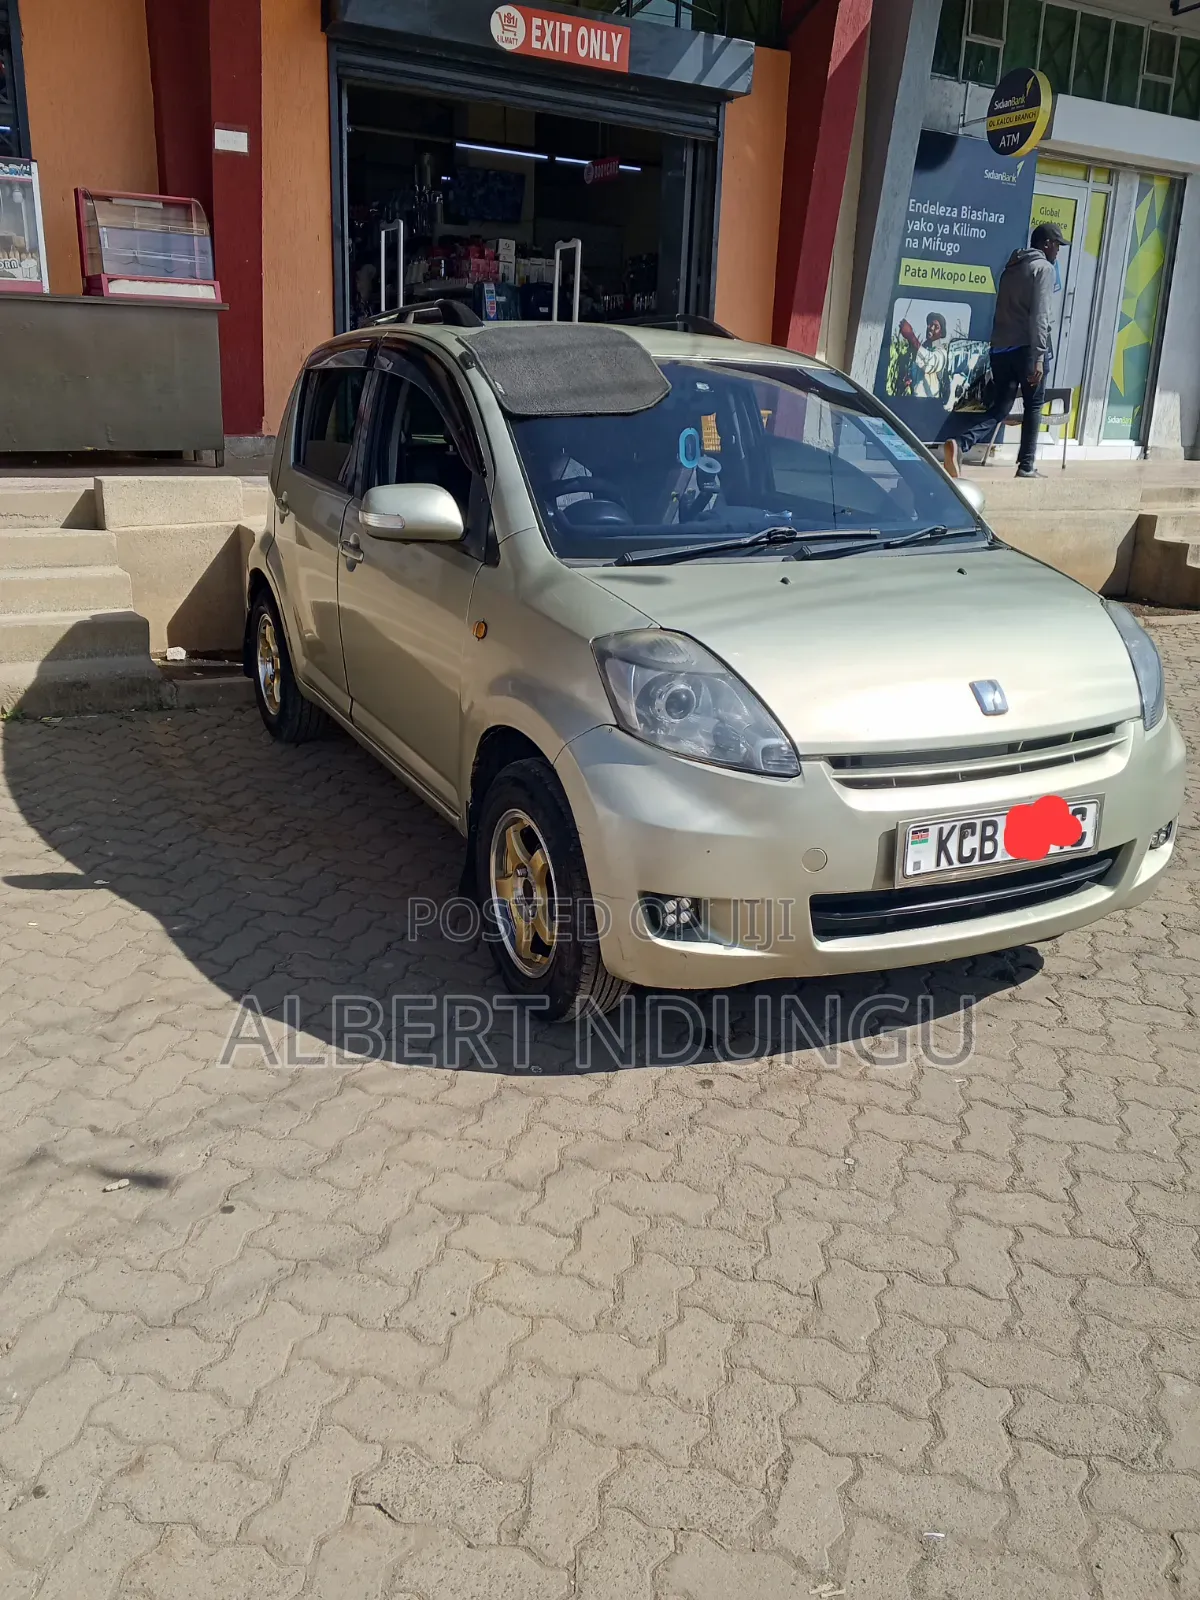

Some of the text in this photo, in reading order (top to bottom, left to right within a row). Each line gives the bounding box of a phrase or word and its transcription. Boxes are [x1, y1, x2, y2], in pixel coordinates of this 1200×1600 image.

[531, 17, 622, 63] EXIT ONLY
[993, 94, 1025, 110] SidianBank
[988, 111, 1037, 128] OL KALOU BRANCH
[998, 132, 1020, 148] ATM
[984, 169, 1017, 183] SidianBank
[908, 199, 1005, 224] Endeleza Biashara
[1039, 207, 1061, 218] Global
[907, 218, 987, 239] yako ya Kilimo
[905, 237, 960, 256] na Mifugo
[904, 265, 987, 284] Pata Mkopo Leo
[936, 819, 999, 868] KCB
